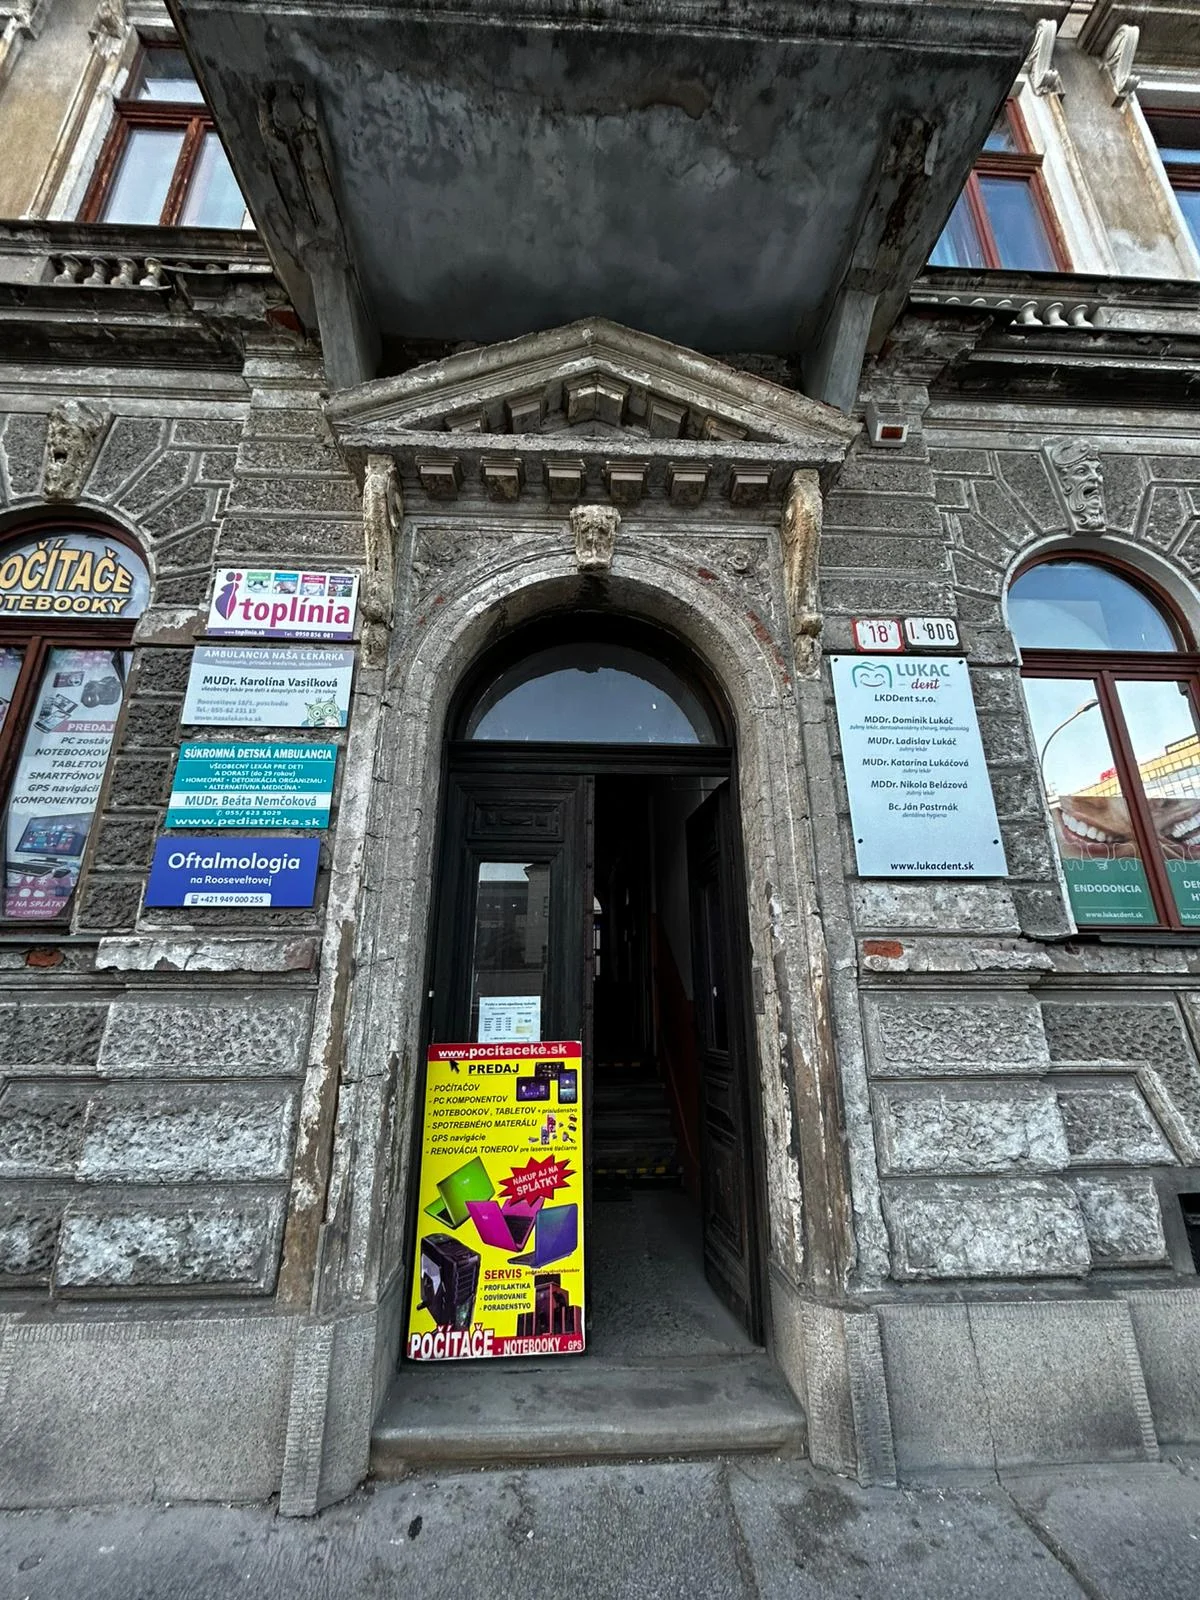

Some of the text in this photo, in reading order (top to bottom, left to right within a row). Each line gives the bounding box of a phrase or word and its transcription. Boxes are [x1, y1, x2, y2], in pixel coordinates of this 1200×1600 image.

[0, 594, 131, 614] TEBOOKY
[239, 597, 351, 627] toplínia
[869, 625, 889, 643] 18
[926, 623, 955, 640] 806
[204, 650, 345, 661] AMBULANCIA NAŠA LEKÁRKA
[203, 675, 237, 686] MUDr.
[240, 676, 285, 687] Karolína
[911, 678, 940, 690] dent
[915, 695, 936, 703] s.r.o.
[892, 716, 928, 724] Dominik
[67, 723, 114, 731] PREDAJ
[868, 737, 957, 745] MUDr. Ladislav Lukáč
[35, 749, 109, 757] NOTEBOOKOV
[184, 746, 332, 759] SÚKROMNÁ DETSKÁ AMBULANCIA
[862, 758, 889, 766] MUDr.
[891, 758, 928, 766] Katarína
[28, 772, 103, 780] SMARTFÓNOV
[871, 780, 898, 788] MDDr.
[929, 781, 968, 789] Belázová
[12, 797, 97, 805] KOMPONENTOV
[185, 795, 317, 806] MUDr. Beáta Nemčoková
[888, 803, 958, 811] Bc. Ján Pastrnák
[175, 817, 320, 827] www.pediatricka.sk
[168, 852, 300, 874] Oftalmologia
[891, 861, 974, 871] www.lukacdent.sk
[205, 875, 272, 887] Rooseveltovej
[1073, 884, 1142, 893] ENDODONCIA
[468, 1063, 520, 1074] PREDAJ
[434, 1083, 480, 1092] POČÍTAČOV
[446, 1095, 508, 1104] KOMPONENTOV
[432, 1108, 490, 1117] NOTEBOOKOV
[495, 1106, 537, 1115] TABLETOV
[432, 1120, 492, 1129] SPOTREBNÉHO
[450, 1134, 486, 1142] navigácie
[430, 1146, 478, 1155] RENOVÁCIA
[480, 1145, 519, 1153] TONEROV
[512, 1165, 559, 1186] NÁKUP AJ NA
[516, 1174, 558, 1196] SPLÁTKY
[484, 1268, 522, 1280] SERVIS
[483, 1283, 531, 1291] PROFILAKTIKA
[483, 1293, 527, 1301] ODVÍROVANIE
[483, 1303, 531, 1311] PORADENSTVO
[410, 1323, 582, 1359] POČÍTAČE NOTEBOOKY GPS
